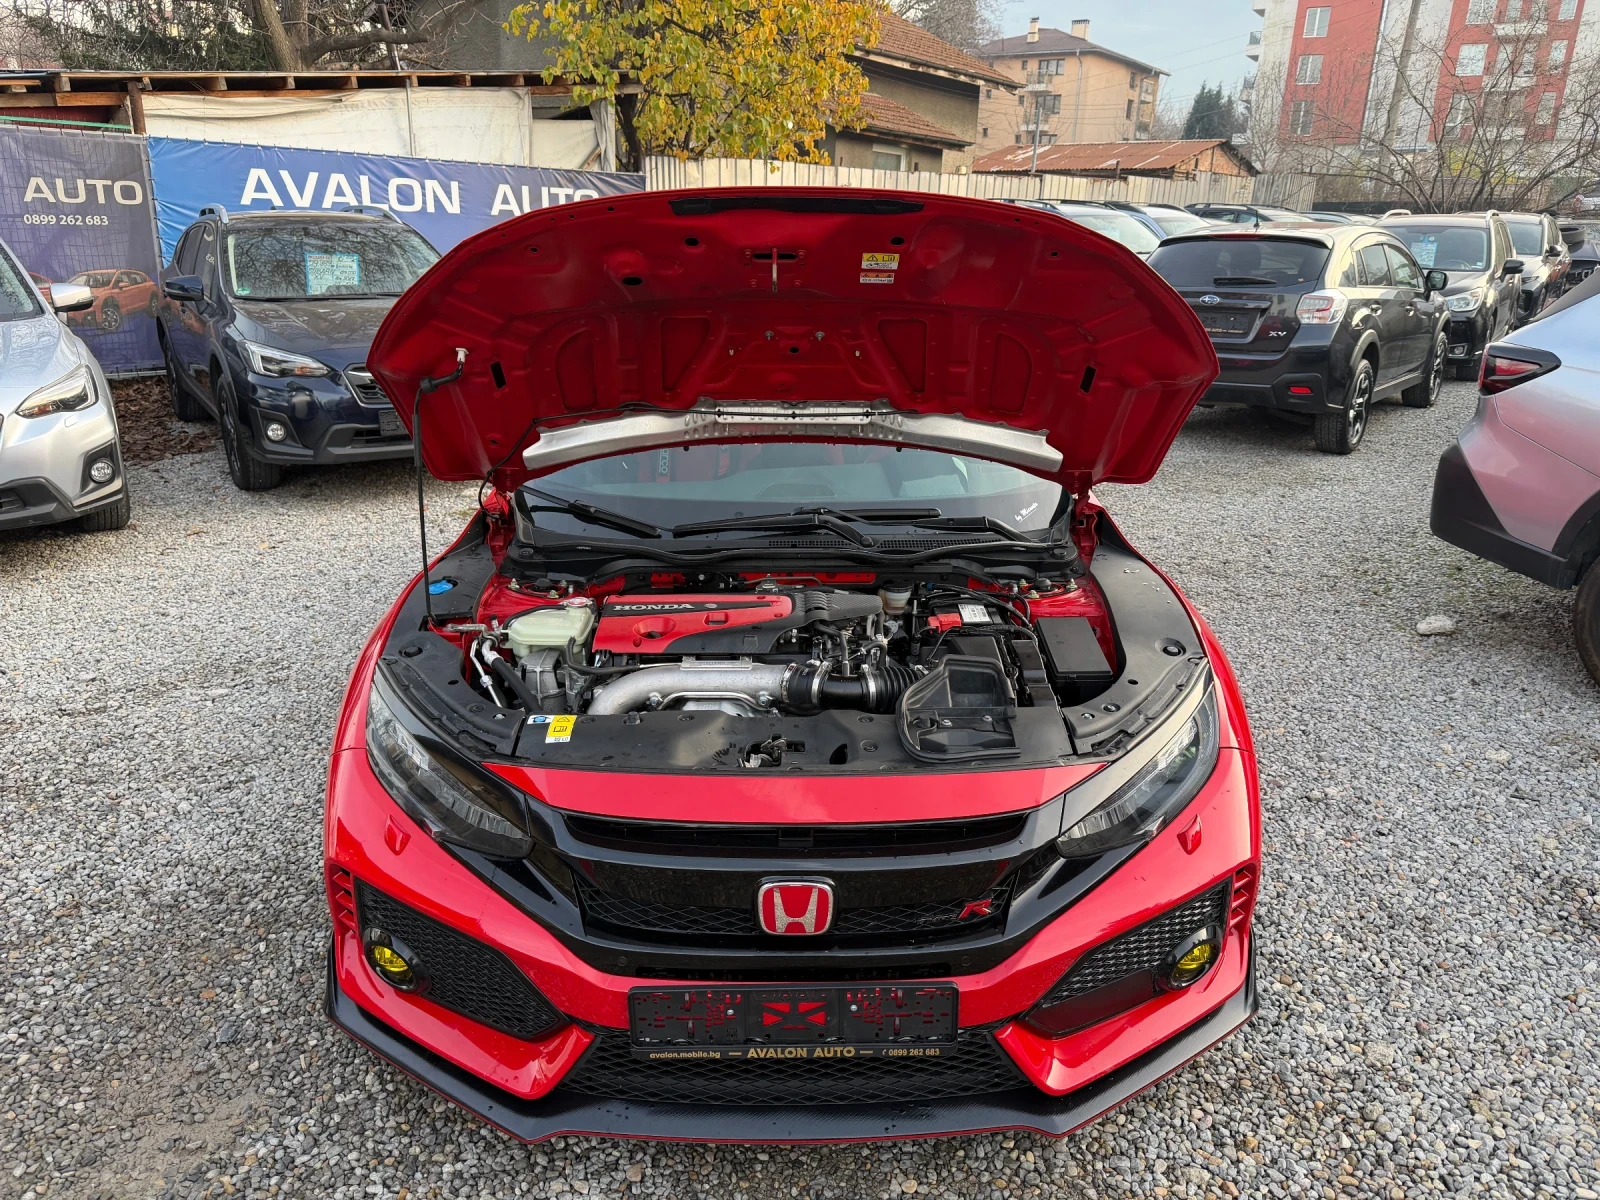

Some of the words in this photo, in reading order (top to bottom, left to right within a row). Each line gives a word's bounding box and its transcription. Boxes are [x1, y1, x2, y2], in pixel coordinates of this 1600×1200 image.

[23, 176, 143, 205] AUTO
[240, 167, 461, 214] AVALON
[23, 214, 57, 225] 0899
[59, 214, 84, 226] 262
[85, 215, 109, 226] 683
[613, 603, 695, 611] HONDA
[649, 1051, 721, 1059] avalon.mobile.bg
[747, 1047, 808, 1058] AVALON
[813, 1046, 855, 1058] AUTO
[925, 1048, 940, 1056] 683
